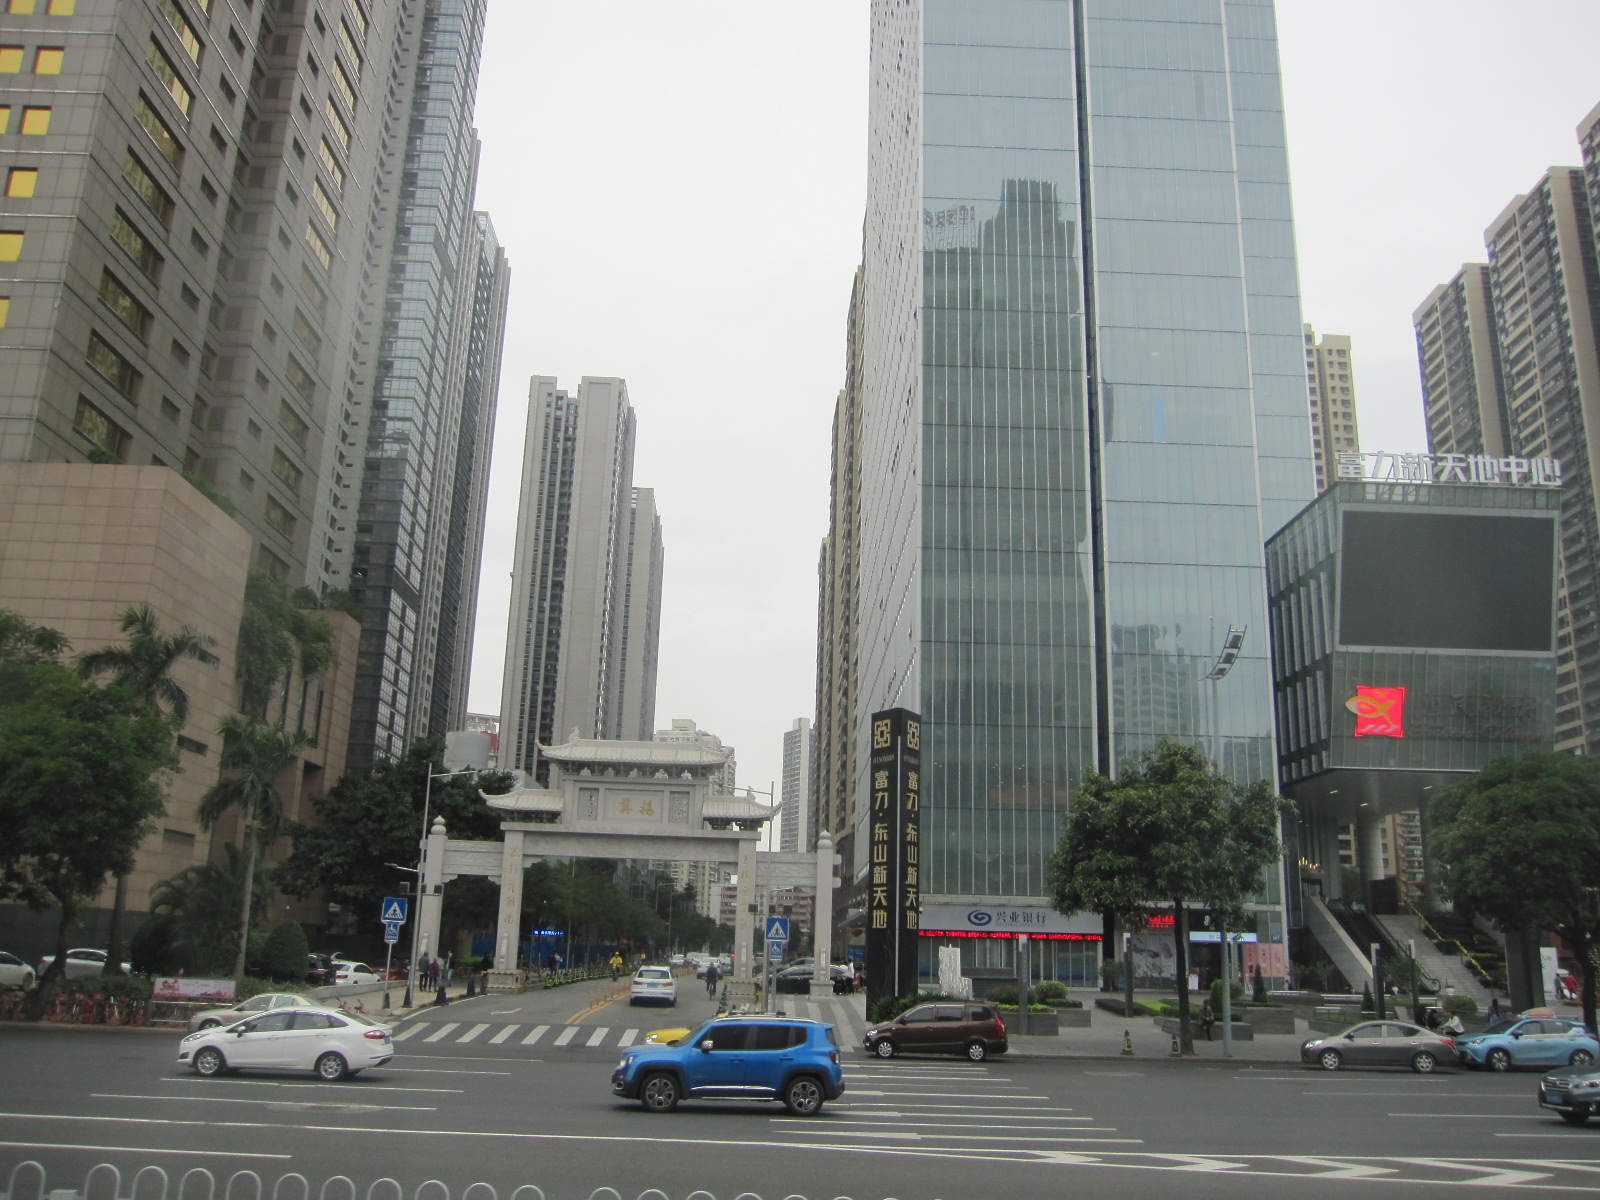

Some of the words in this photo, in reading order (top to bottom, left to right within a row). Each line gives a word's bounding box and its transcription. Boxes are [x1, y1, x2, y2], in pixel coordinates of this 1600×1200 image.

[1335, 451, 1562, 485] 富力新天地中心
[996, 911, 1046, 923] 兴业银行
